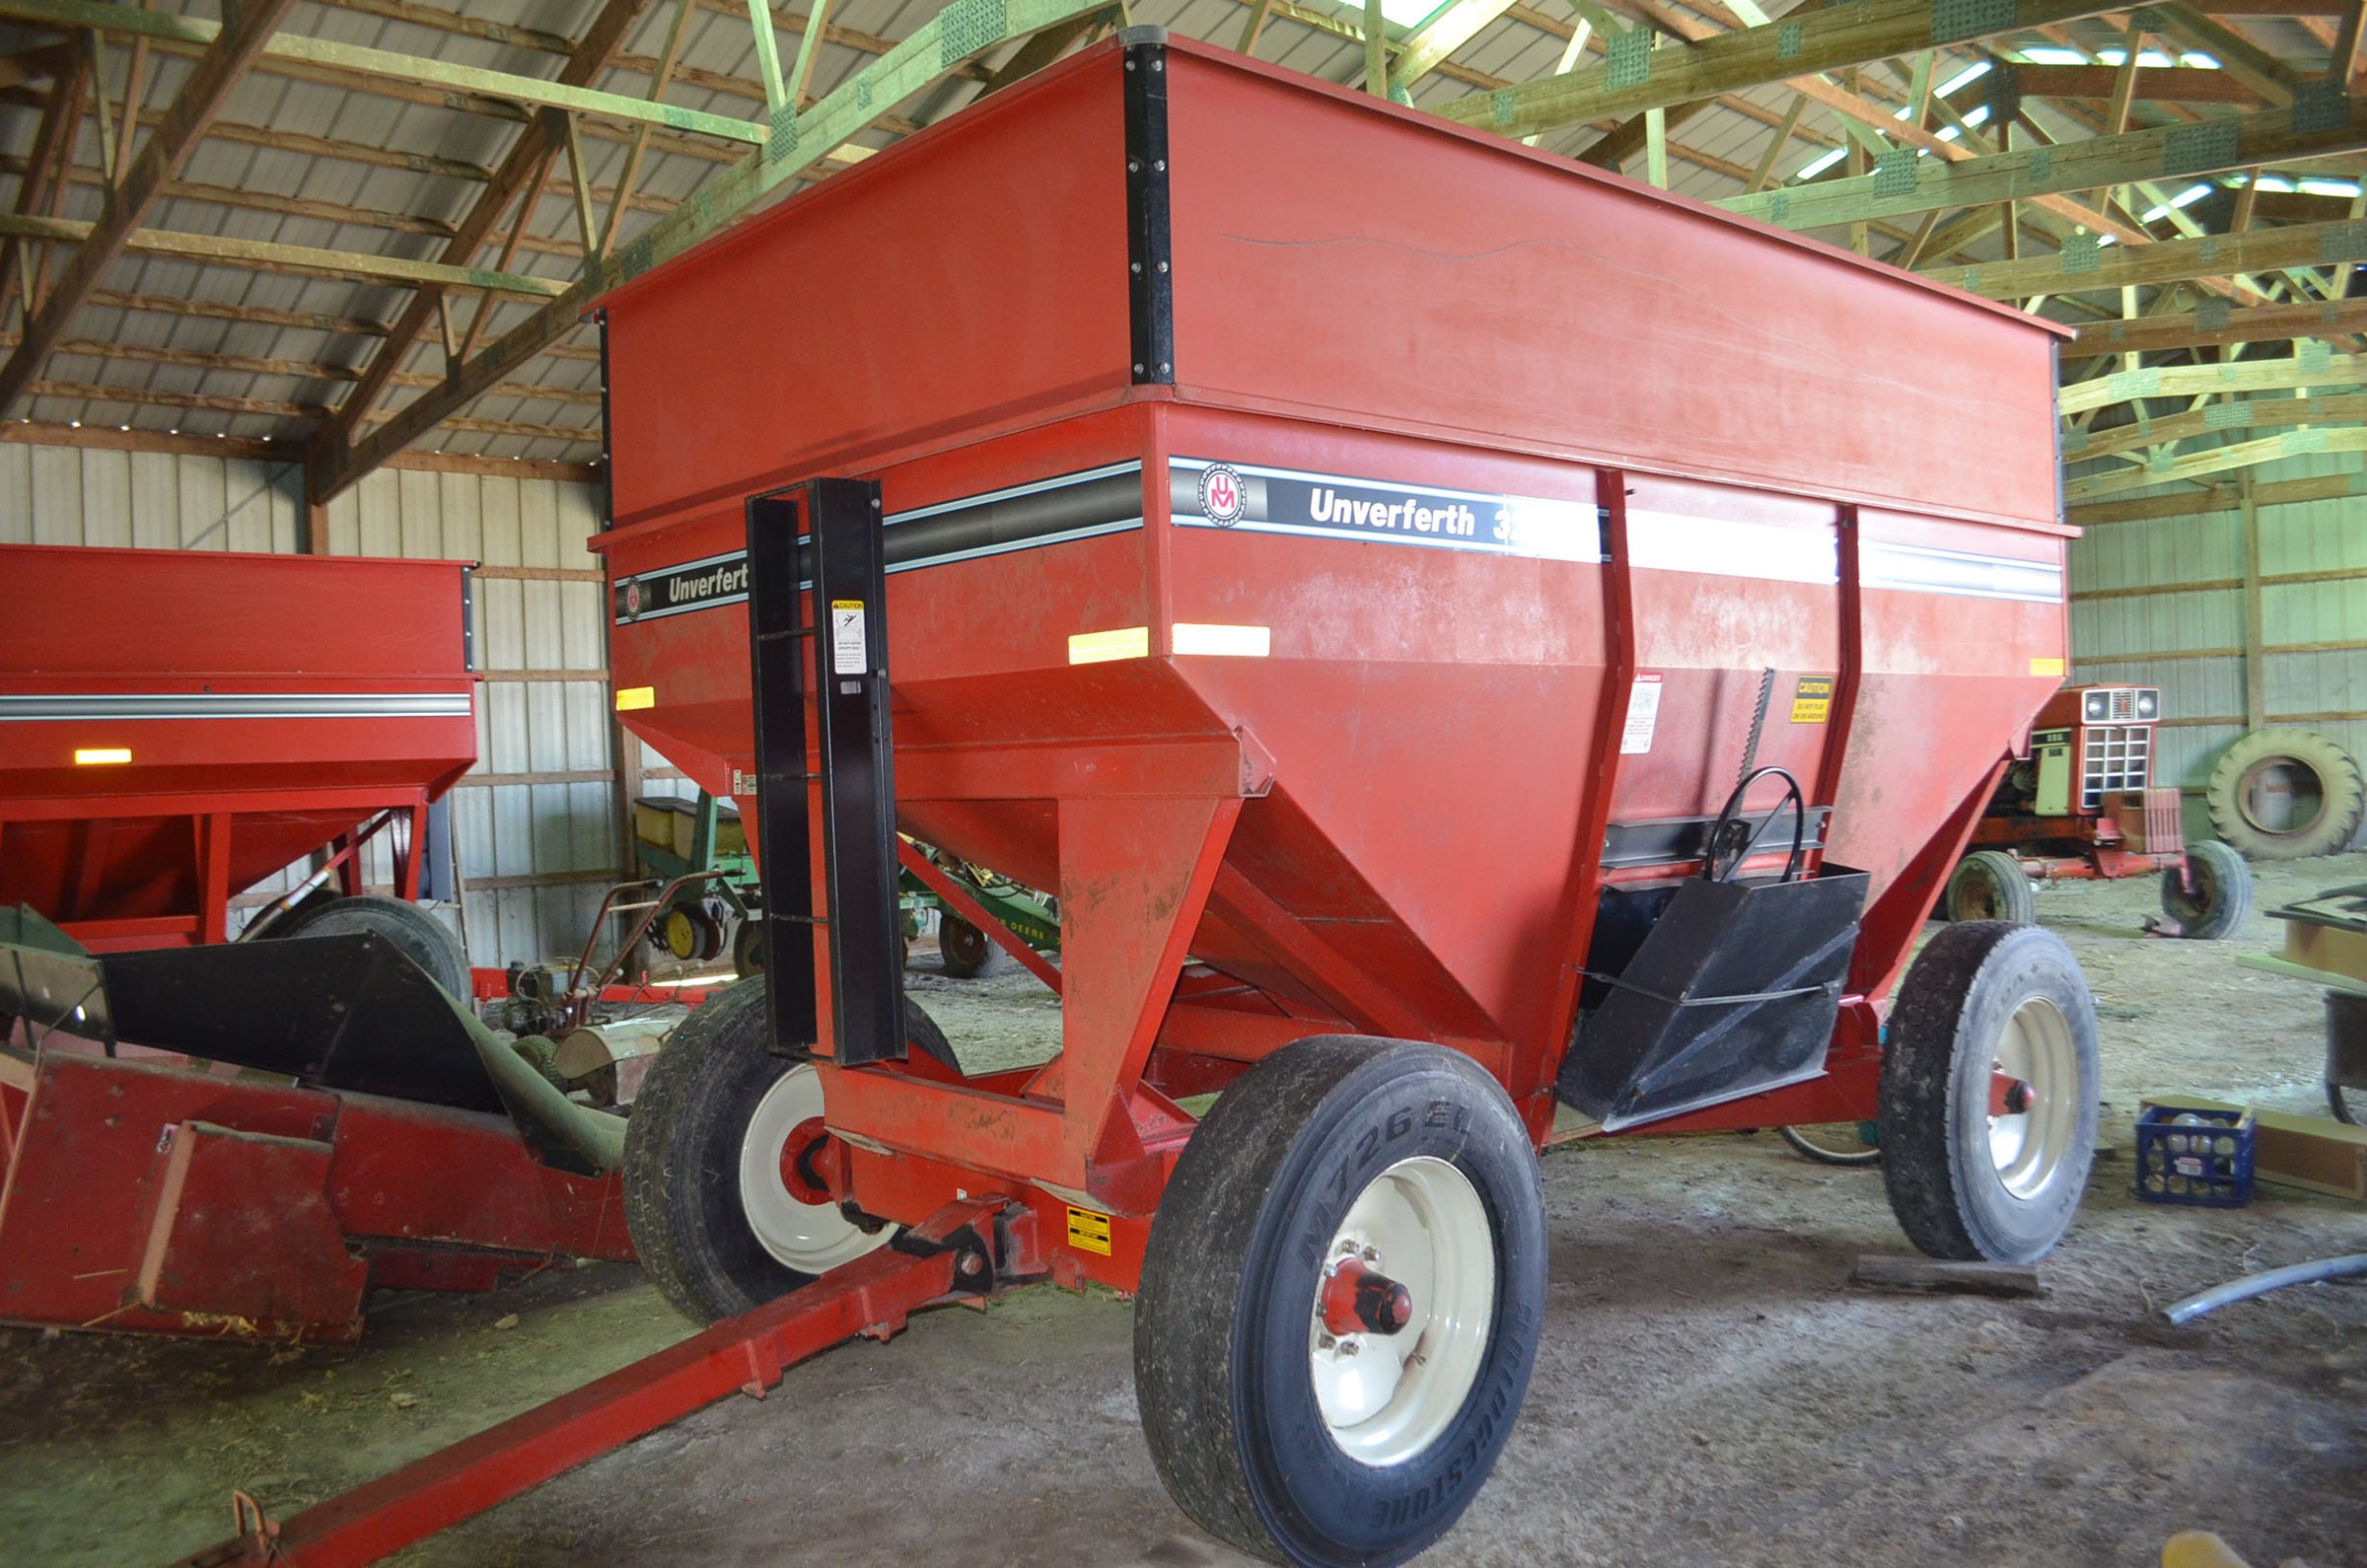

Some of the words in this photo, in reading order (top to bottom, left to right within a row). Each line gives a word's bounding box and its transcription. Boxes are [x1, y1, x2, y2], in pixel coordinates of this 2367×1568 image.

[1310, 488, 1475, 536] Unverferth
[670, 563, 749, 603] Unverfert
[1799, 681, 1829, 693] CAUTION
[1011, 921, 1045, 940] DEERE
